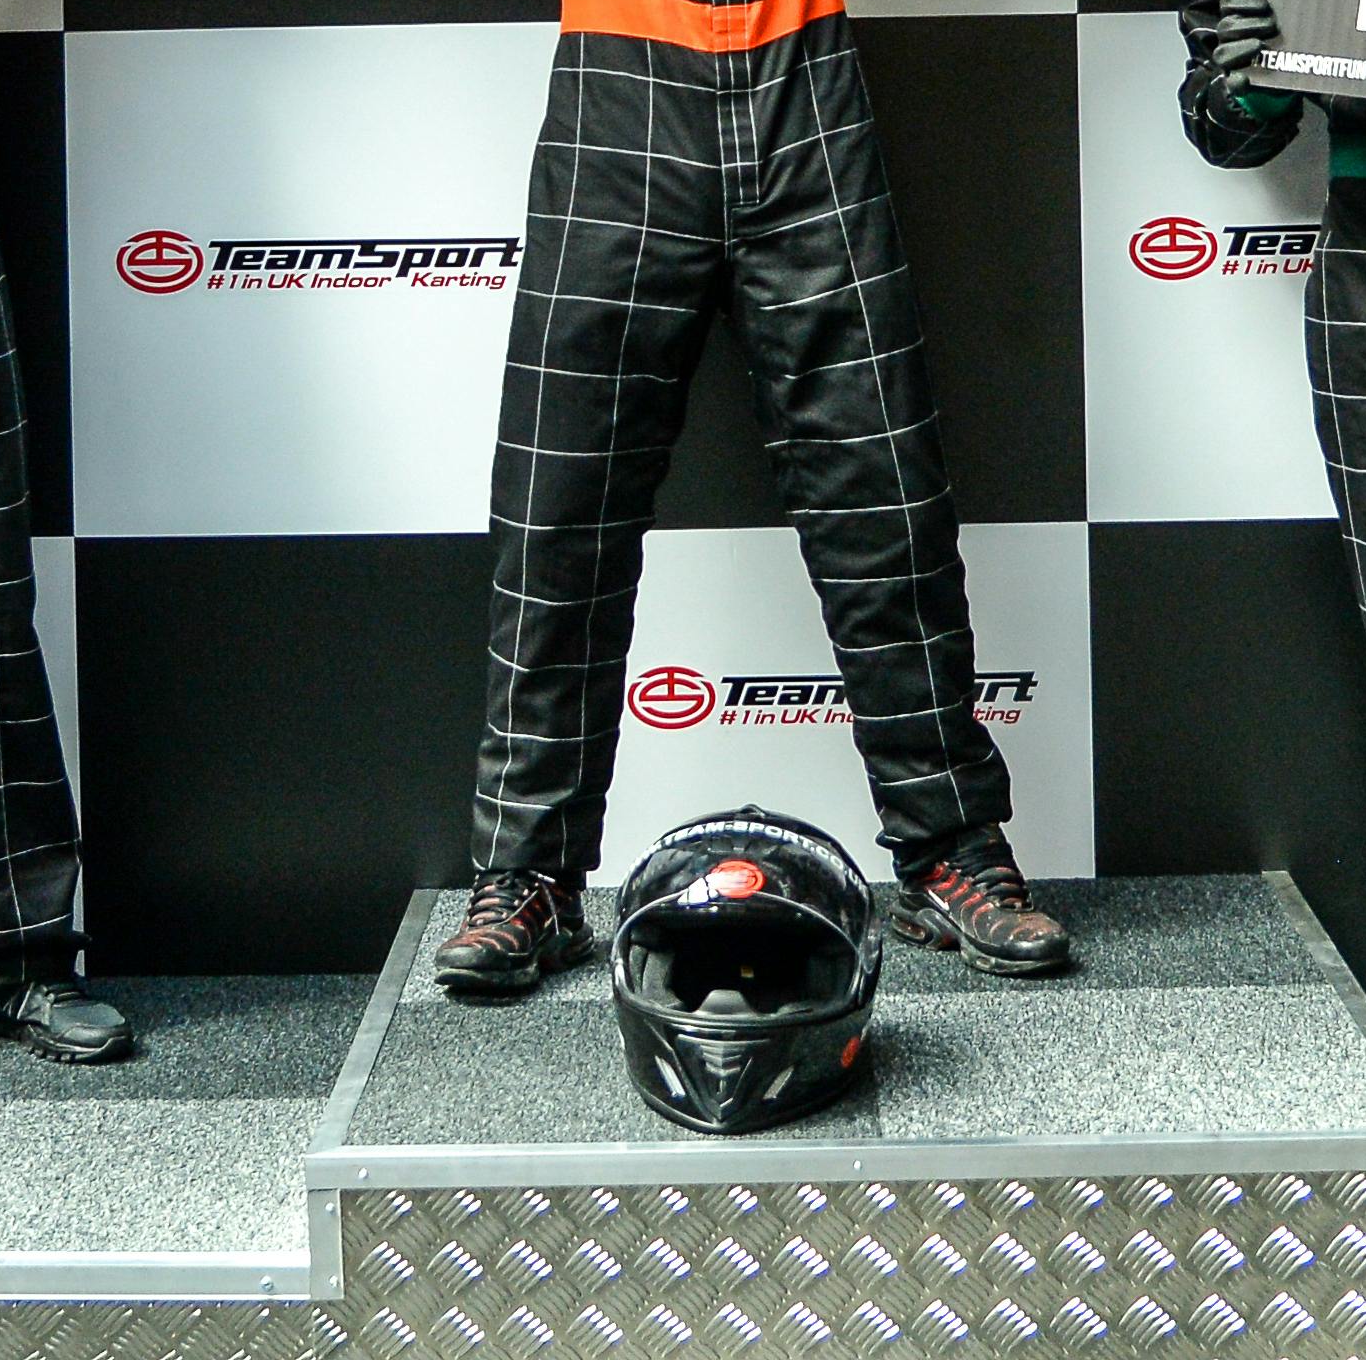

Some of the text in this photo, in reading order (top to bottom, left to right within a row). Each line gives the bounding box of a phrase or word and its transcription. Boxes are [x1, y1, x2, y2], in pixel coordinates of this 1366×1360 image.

[208, 237, 524, 277] TeamSport
[267, 273, 308, 289] UK
[309, 273, 392, 289] Indoor
[410, 271, 507, 290] Karting
[780, 708, 821, 724] UK
